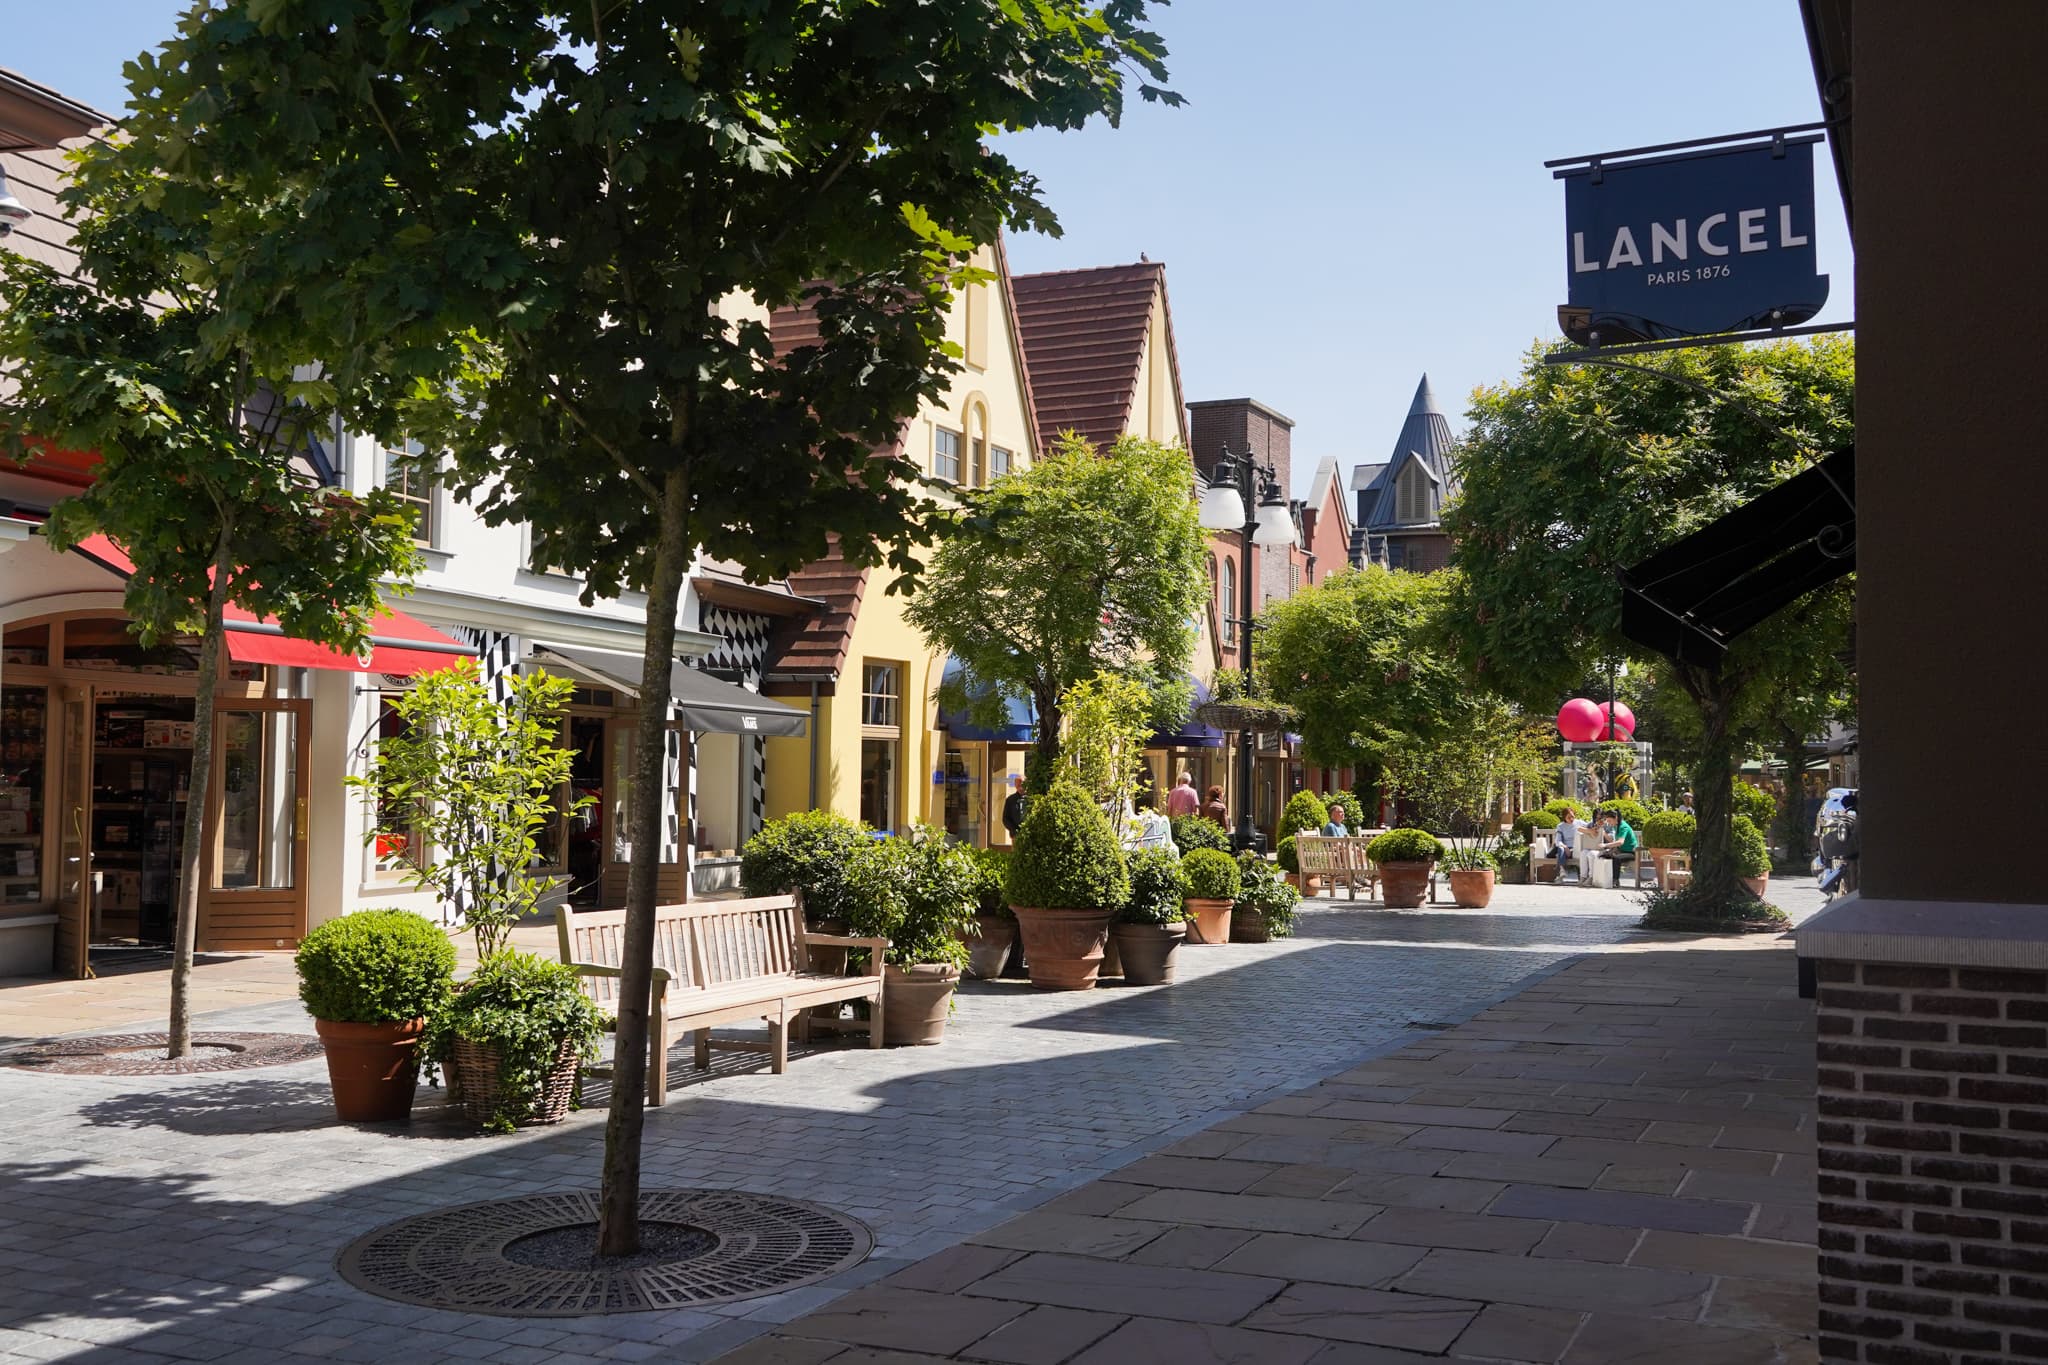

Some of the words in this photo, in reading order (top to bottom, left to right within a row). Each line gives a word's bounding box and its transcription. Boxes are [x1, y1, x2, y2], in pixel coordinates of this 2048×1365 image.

[1573, 204, 1808, 272] LANCEL
[1647, 269, 1691, 286] PARIS
[1696, 264, 1731, 280] 1876
